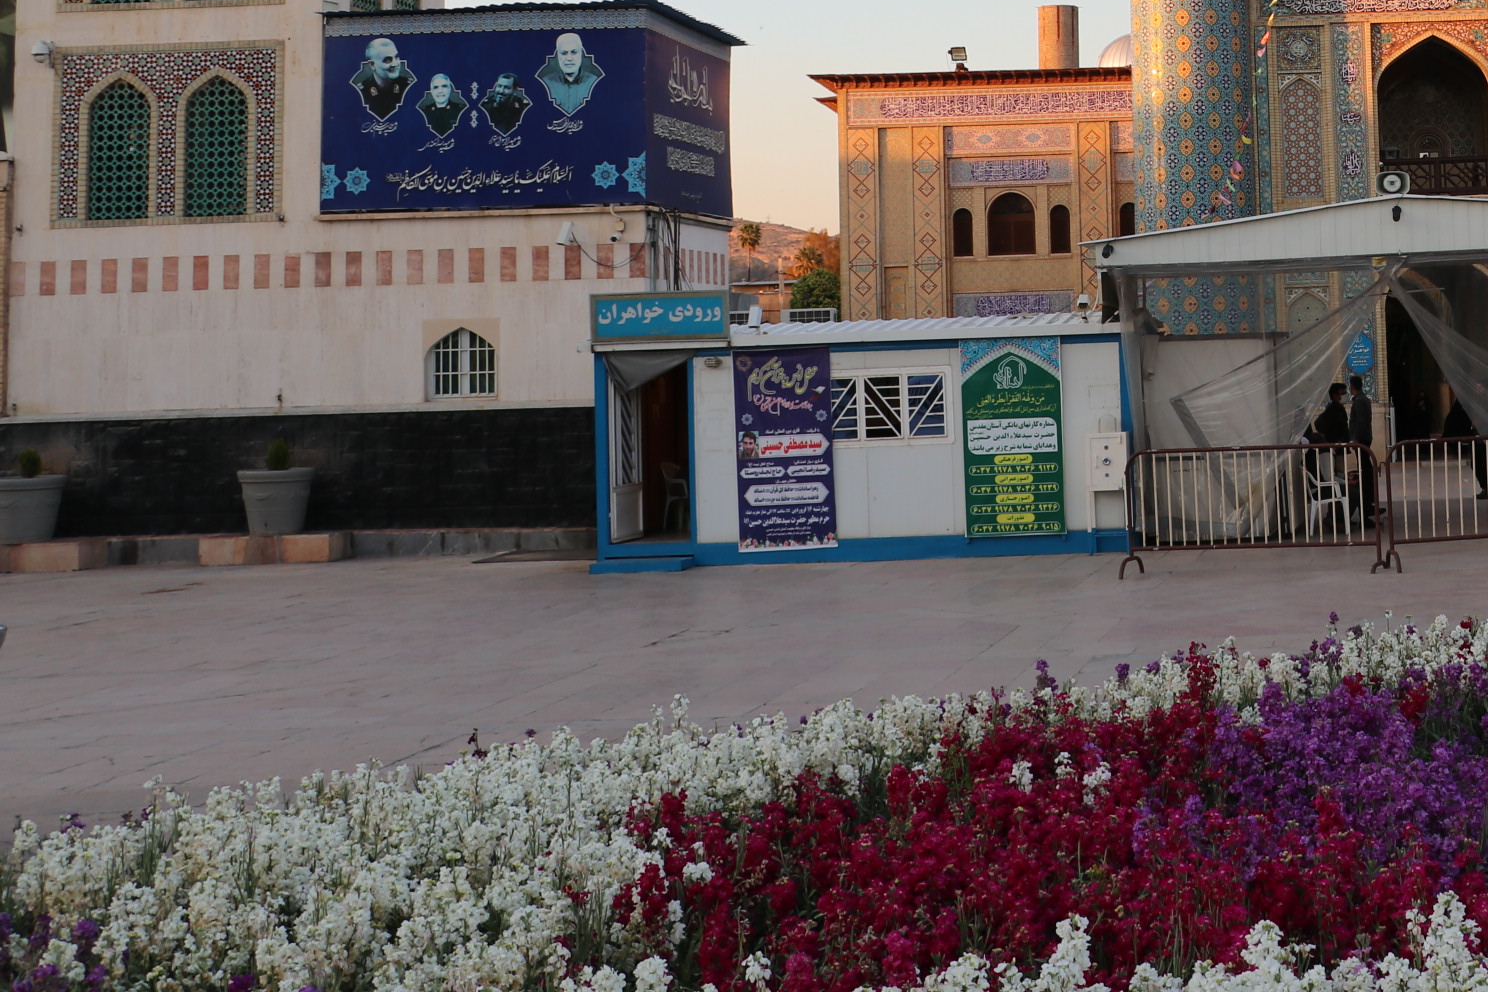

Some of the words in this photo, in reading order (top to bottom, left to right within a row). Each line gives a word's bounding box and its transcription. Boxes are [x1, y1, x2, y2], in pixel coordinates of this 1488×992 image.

[598, 301, 664, 325] خواهران
[668, 303, 722, 322] ورودی
[969, 423, 987, 431] مقدس
[986, 420, 1002, 430] آستان
[1002, 421, 1018, 430] بانکی
[1039, 420, 1055, 429] شماره
[993, 433, 1009, 441] الدین
[760, 440, 783, 455] حسینی
[783, 437, 808, 454] مصطفی
[1003, 444, 1016, 452] شرح
[1007, 514, 1025, 522] نذورات
